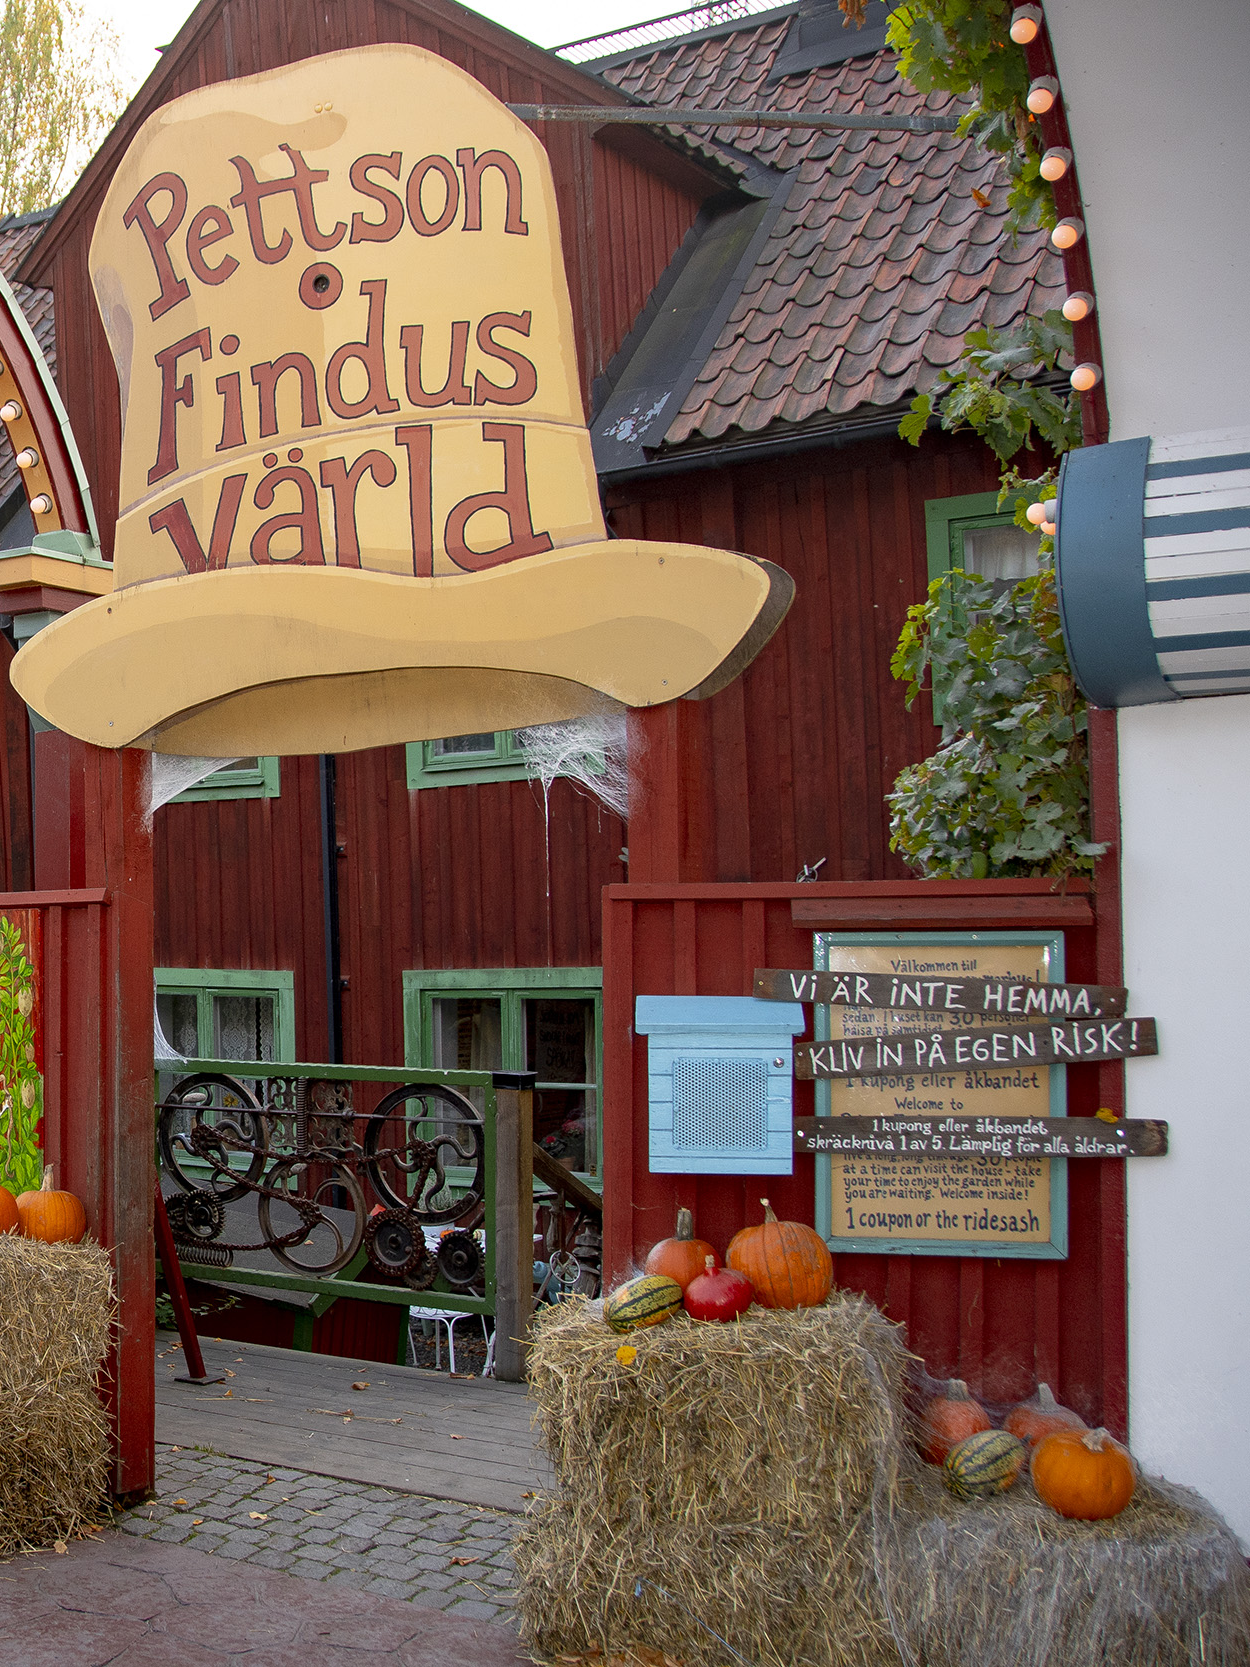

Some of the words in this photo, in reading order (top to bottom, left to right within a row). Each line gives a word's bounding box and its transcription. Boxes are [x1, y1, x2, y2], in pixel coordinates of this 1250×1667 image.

[122, 143, 529, 322] Pettson
[147, 278, 538, 486] Findus
[890, 959, 958, 973] Välkommen
[961, 959, 977, 971] till
[831, 975, 873, 1004] ÄR
[983, 984, 1101, 1016] HEMMA,
[923, 1011, 944, 1023] kan
[949, 1012, 974, 1025] 30
[809, 1042, 864, 1074] KLIV
[914, 1034, 947, 1068] PÅ
[955, 1032, 1037, 1063] EGEN
[861, 1075, 915, 1092] kupong
[921, 1073, 956, 1089] eller
[964, 1070, 1040, 1089] åkbandet
[894, 1096, 944, 1110] Welcome
[950, 1098, 963, 1110] to
[882, 1119, 932, 1135] kupong
[938, 1118, 969, 1132] eller
[807, 1133, 894, 1151] skräcknivå
[909, 1139, 928, 1150] av
[949, 1135, 1013, 1156] Lämplig
[1016, 1136, 1041, 1153] för
[1043, 1136, 1070, 1154] alla
[843, 1164, 856, 1174] at
[860, 1165, 868, 1174] a
[870, 1163, 897, 1175] time
[900, 1165, 921, 1175] can
[923, 1163, 948, 1174] visit
[951, 1164, 969, 1174] the
[971, 1164, 1003, 1176] house
[1015, 1165, 1042, 1176] take
[843, 1177, 871, 1190] your
[874, 1177, 896, 1187] time
[898, 1177, 910, 1186] to
[911, 1176, 939, 1189] enjoy
[941, 1175, 960, 1186] the
[962, 1176, 1002, 1189] garden
[1004, 1177, 1035, 1188] while
[844, 1189, 867, 1203] you
[868, 1189, 887, 1199] are
[889, 1187, 935, 1201] waiting.
[940, 1187, 984, 1199] Welcome
[987, 1189, 1029, 1200] inside!
[846, 1207, 855, 1229] 1
[859, 1211, 913, 1232] coupon
[916, 1212, 931, 1228] or
[935, 1209, 958, 1229] the
[962, 1208, 1040, 1233] ridesash
